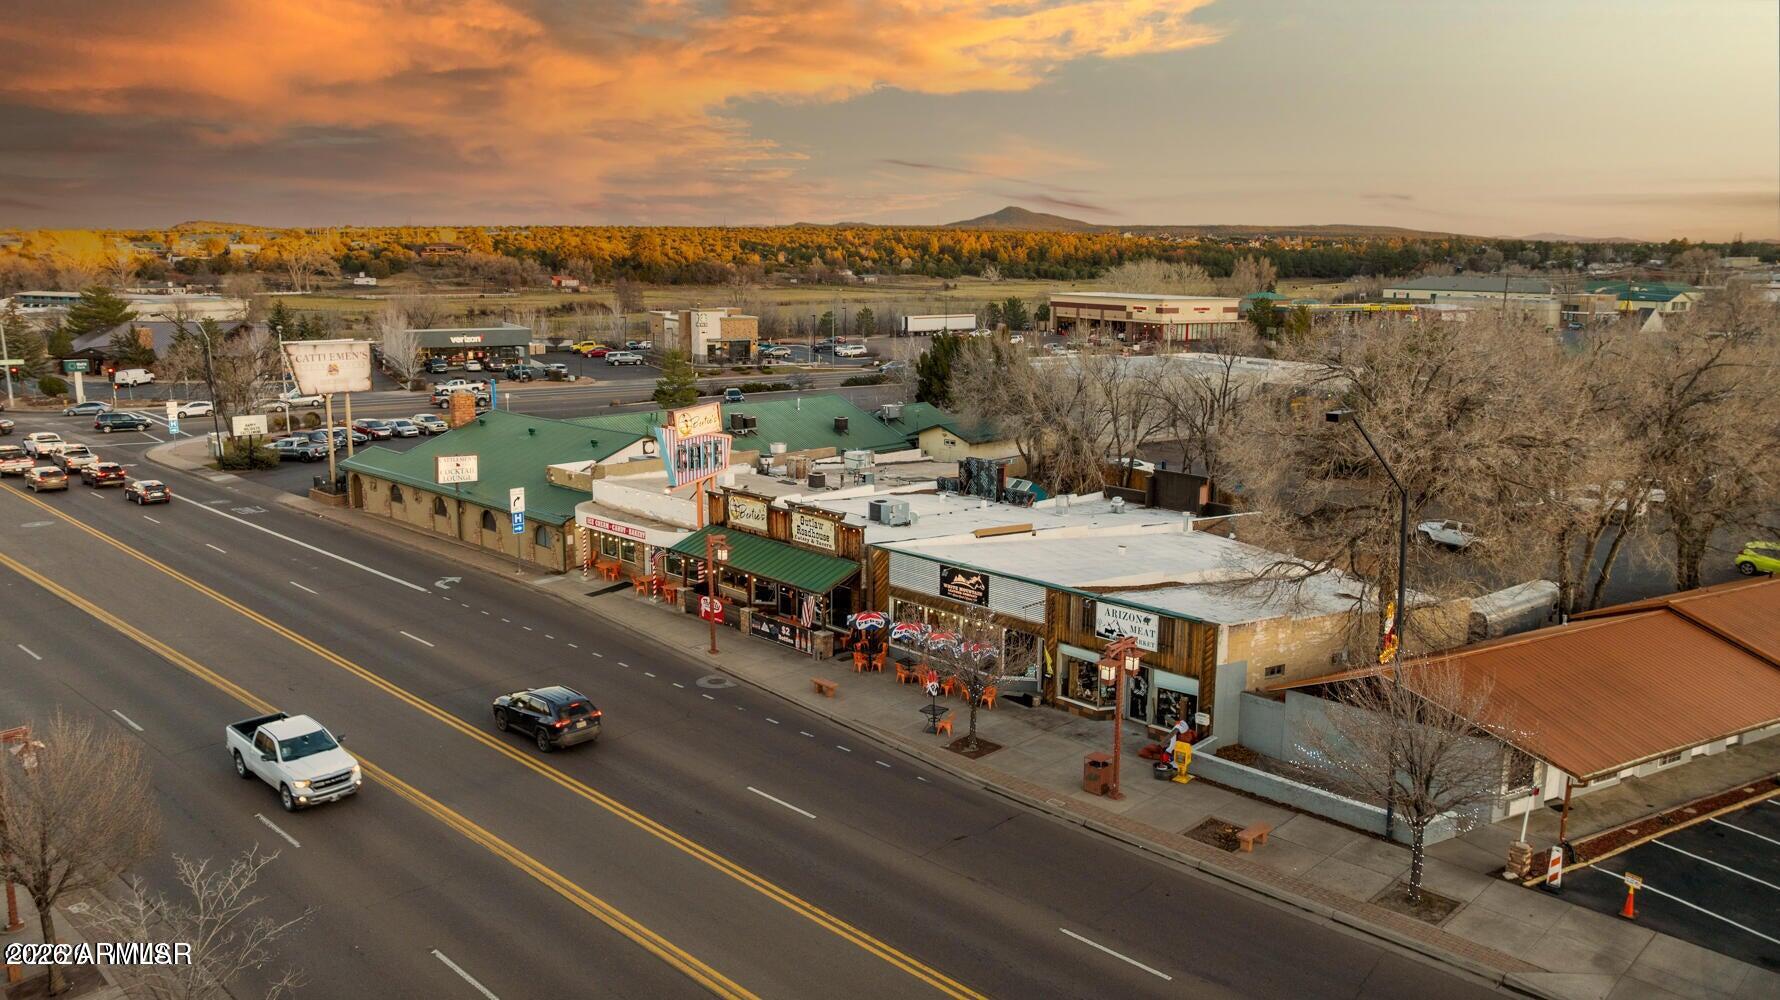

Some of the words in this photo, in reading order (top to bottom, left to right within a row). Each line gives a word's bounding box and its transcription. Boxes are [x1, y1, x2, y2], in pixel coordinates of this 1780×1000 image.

[450, 335, 482, 343] verizon
[295, 351, 369, 363] CATTLEMEN'S
[514, 514, 523, 523] H
[800, 516, 824, 530] Outlaw
[796, 525, 830, 542] Roadhouse
[781, 625, 791, 636] $2
[1130, 625, 1156, 638] MEAT
